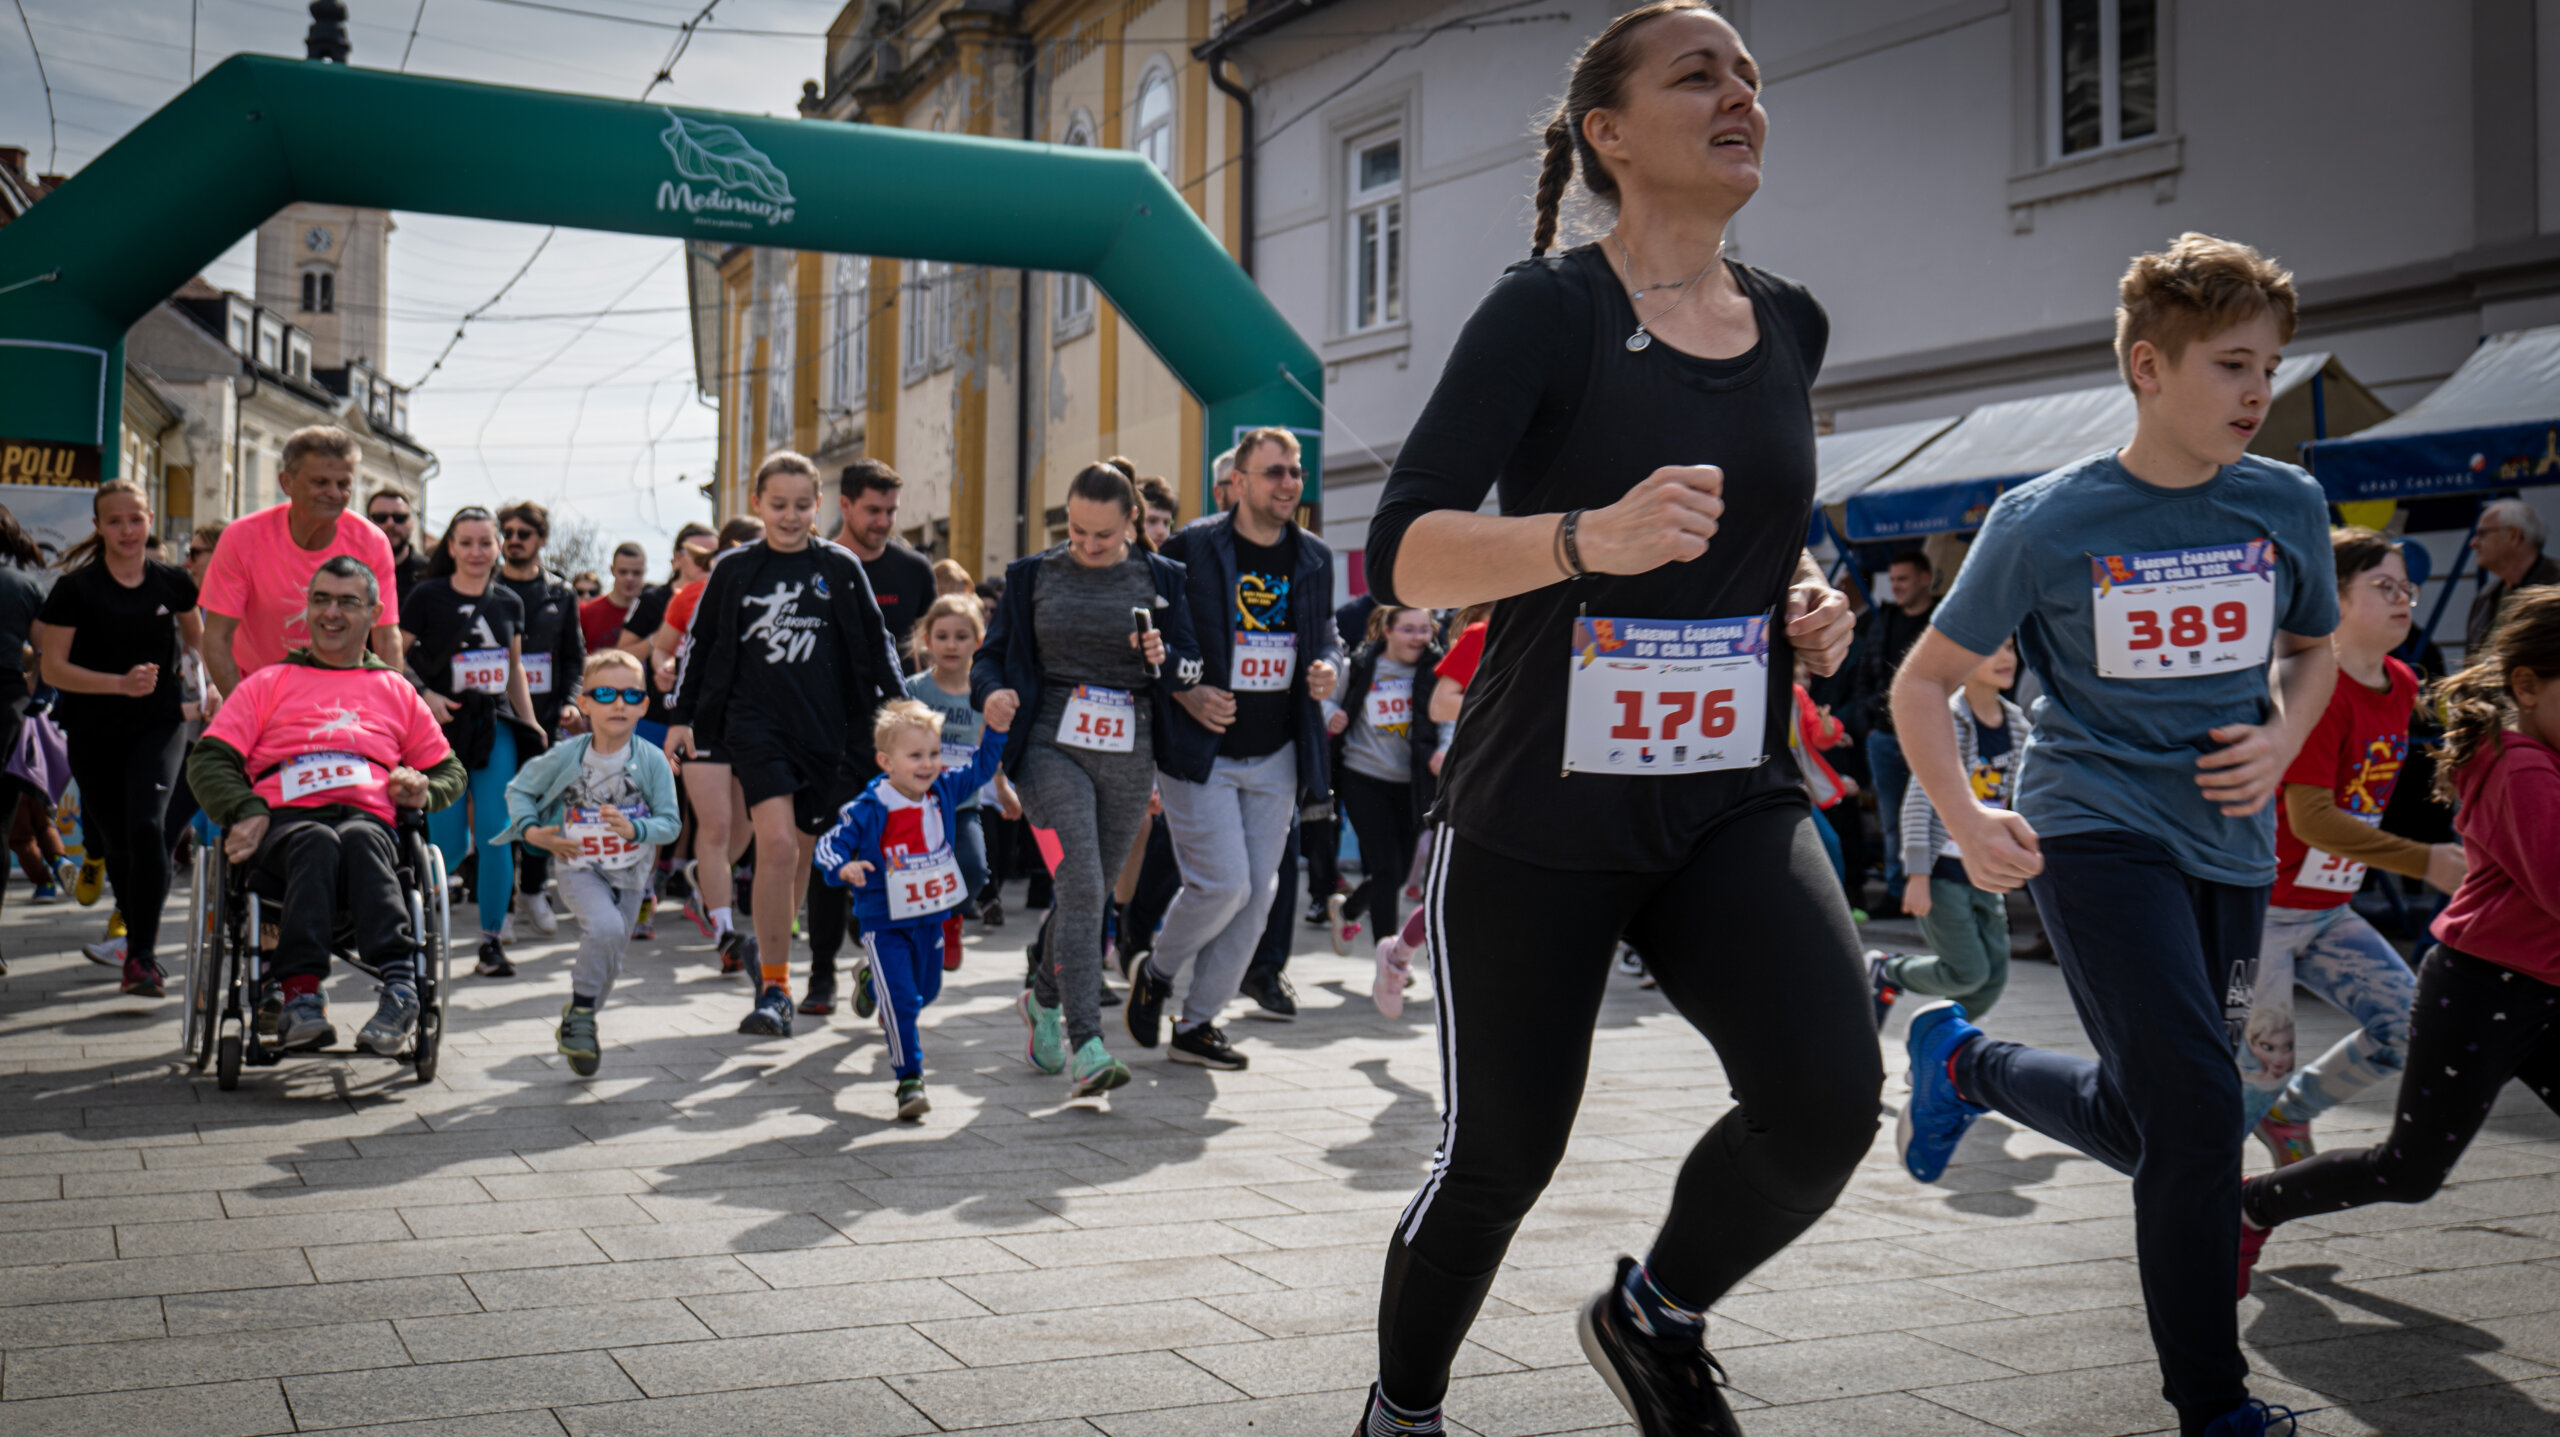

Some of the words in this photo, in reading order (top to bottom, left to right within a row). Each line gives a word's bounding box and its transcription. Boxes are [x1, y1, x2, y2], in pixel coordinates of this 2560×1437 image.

[2, 445, 76, 478] POLU
[2144, 569, 2162, 582] DO
[781, 602, 798, 615] ZA
[2127, 601, 2248, 651] 389
[765, 628, 817, 664] SVI
[1635, 642, 1657, 657] DO
[465, 667, 504, 685] 508
[1241, 658, 1287, 678] 014
[1075, 712, 1125, 738] 161
[1610, 688, 1737, 741] 176
[298, 765, 354, 787] 216
[905, 871, 958, 904] 163
